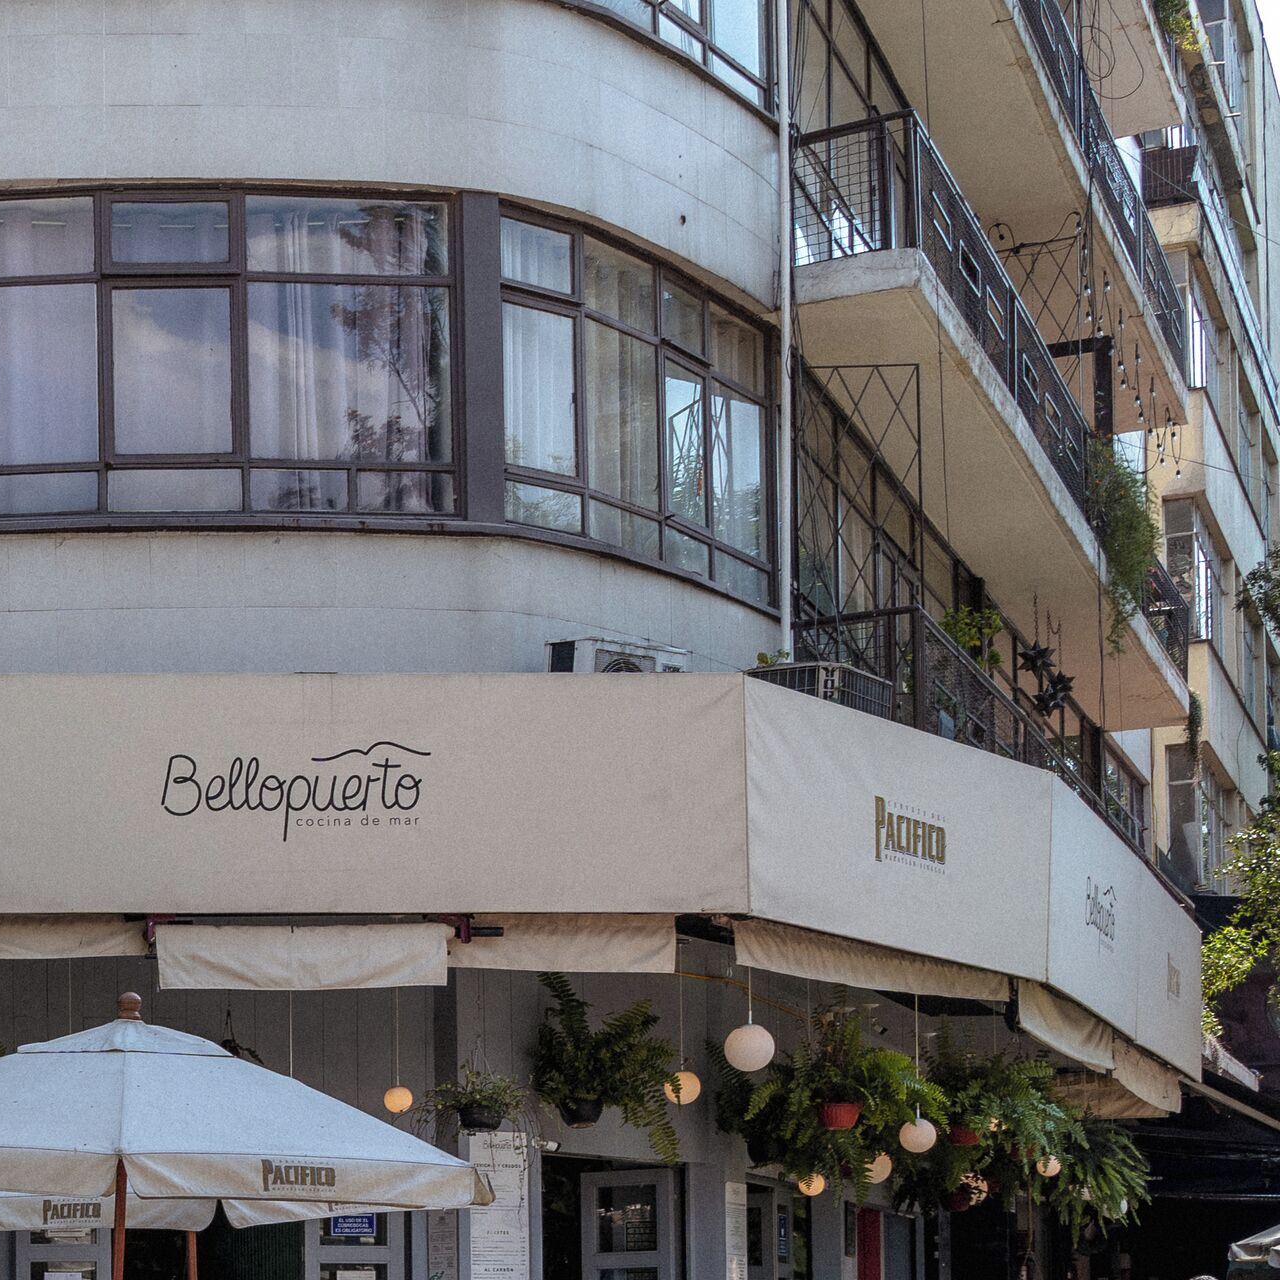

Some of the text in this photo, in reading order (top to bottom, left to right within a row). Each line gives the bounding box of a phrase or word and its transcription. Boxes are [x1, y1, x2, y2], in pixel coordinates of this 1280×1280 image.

[821, 666, 839, 701] YOR
[161, 753, 423, 843] Bellopuerto
[296, 814, 421, 828] cocina de mar
[874, 795, 947, 866] PACIFICO
[261, 1159, 336, 1192] PACIFICO
[42, 1199, 102, 1226] PACIFICO
